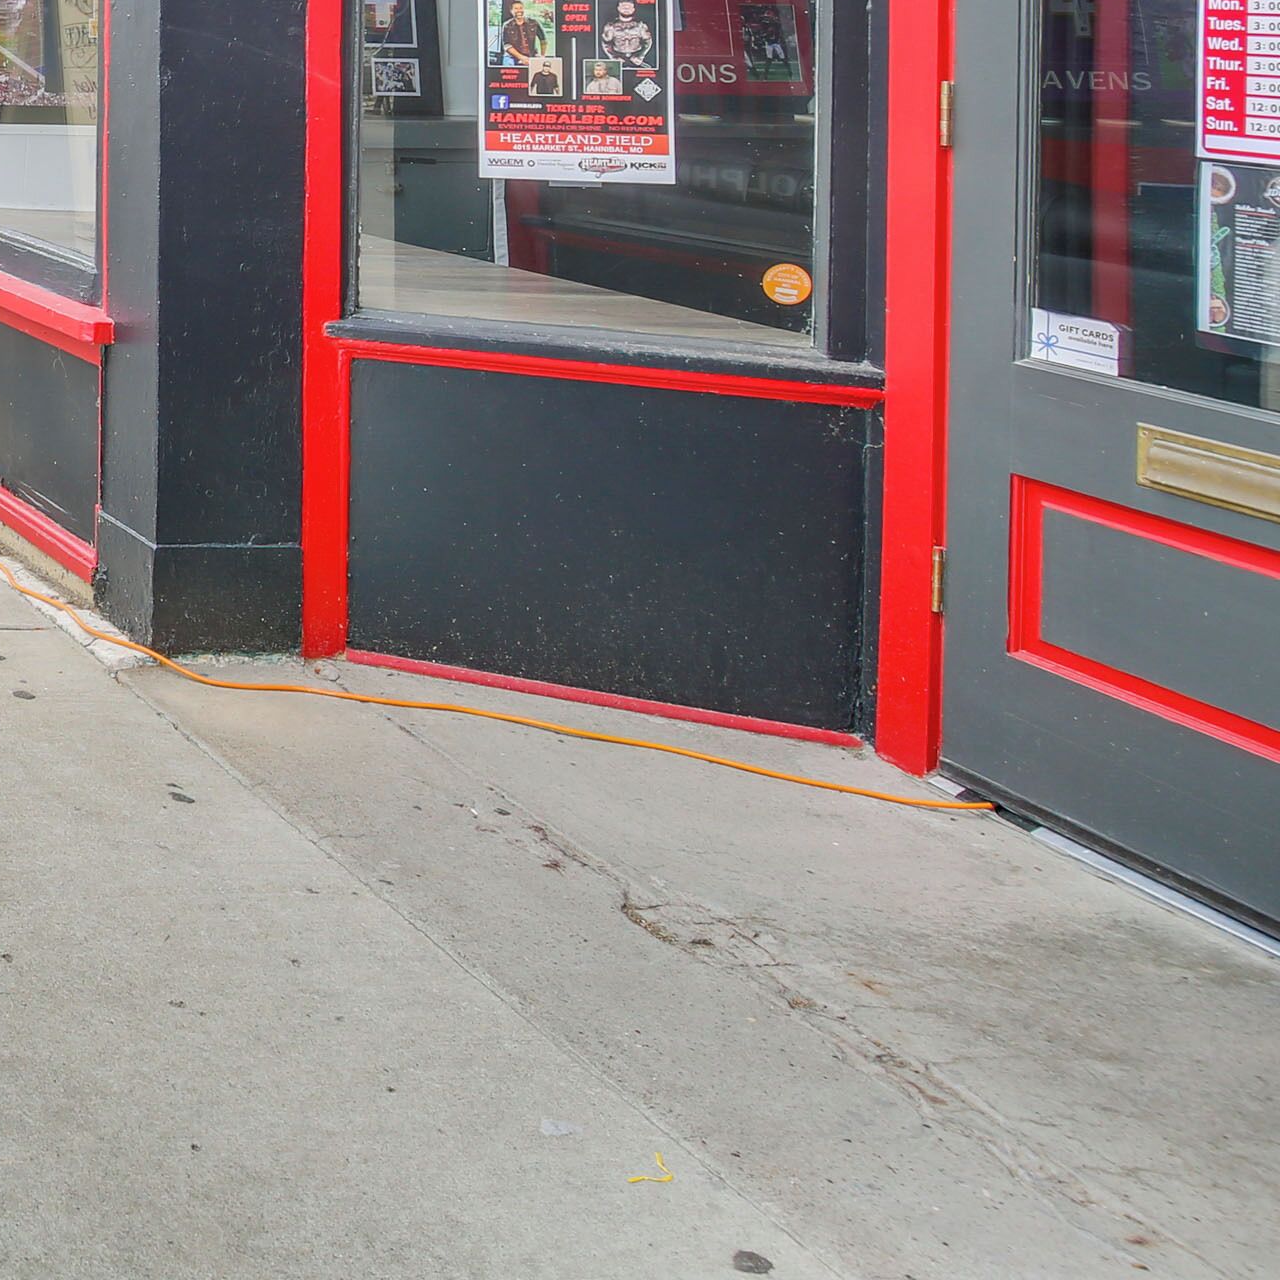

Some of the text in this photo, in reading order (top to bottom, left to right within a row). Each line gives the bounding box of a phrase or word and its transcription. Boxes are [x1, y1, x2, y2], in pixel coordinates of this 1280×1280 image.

[562, 4, 590, 12] GATES
[565, 14, 587, 22] OPEN
[1207, 17, 1246, 31] Tues.
[1207, 37, 1243, 51] Wed.
[1207, 57, 1244, 71] Thur.
[1042, 71, 1153, 91] AVENS
[1206, 77, 1230, 91] Fri.
[546, 104, 576, 113] TICKETS
[1206, 97, 1234, 111] Sat.
[489, 112, 663, 126] HANNIBALBBQ.COM
[1206, 117, 1238, 131] Sun.
[500, 133, 653, 146] HEARTLAND FIELD
[488, 158, 524, 167] WGEM
[1058, 324, 1114, 342] GIFT CARDS
